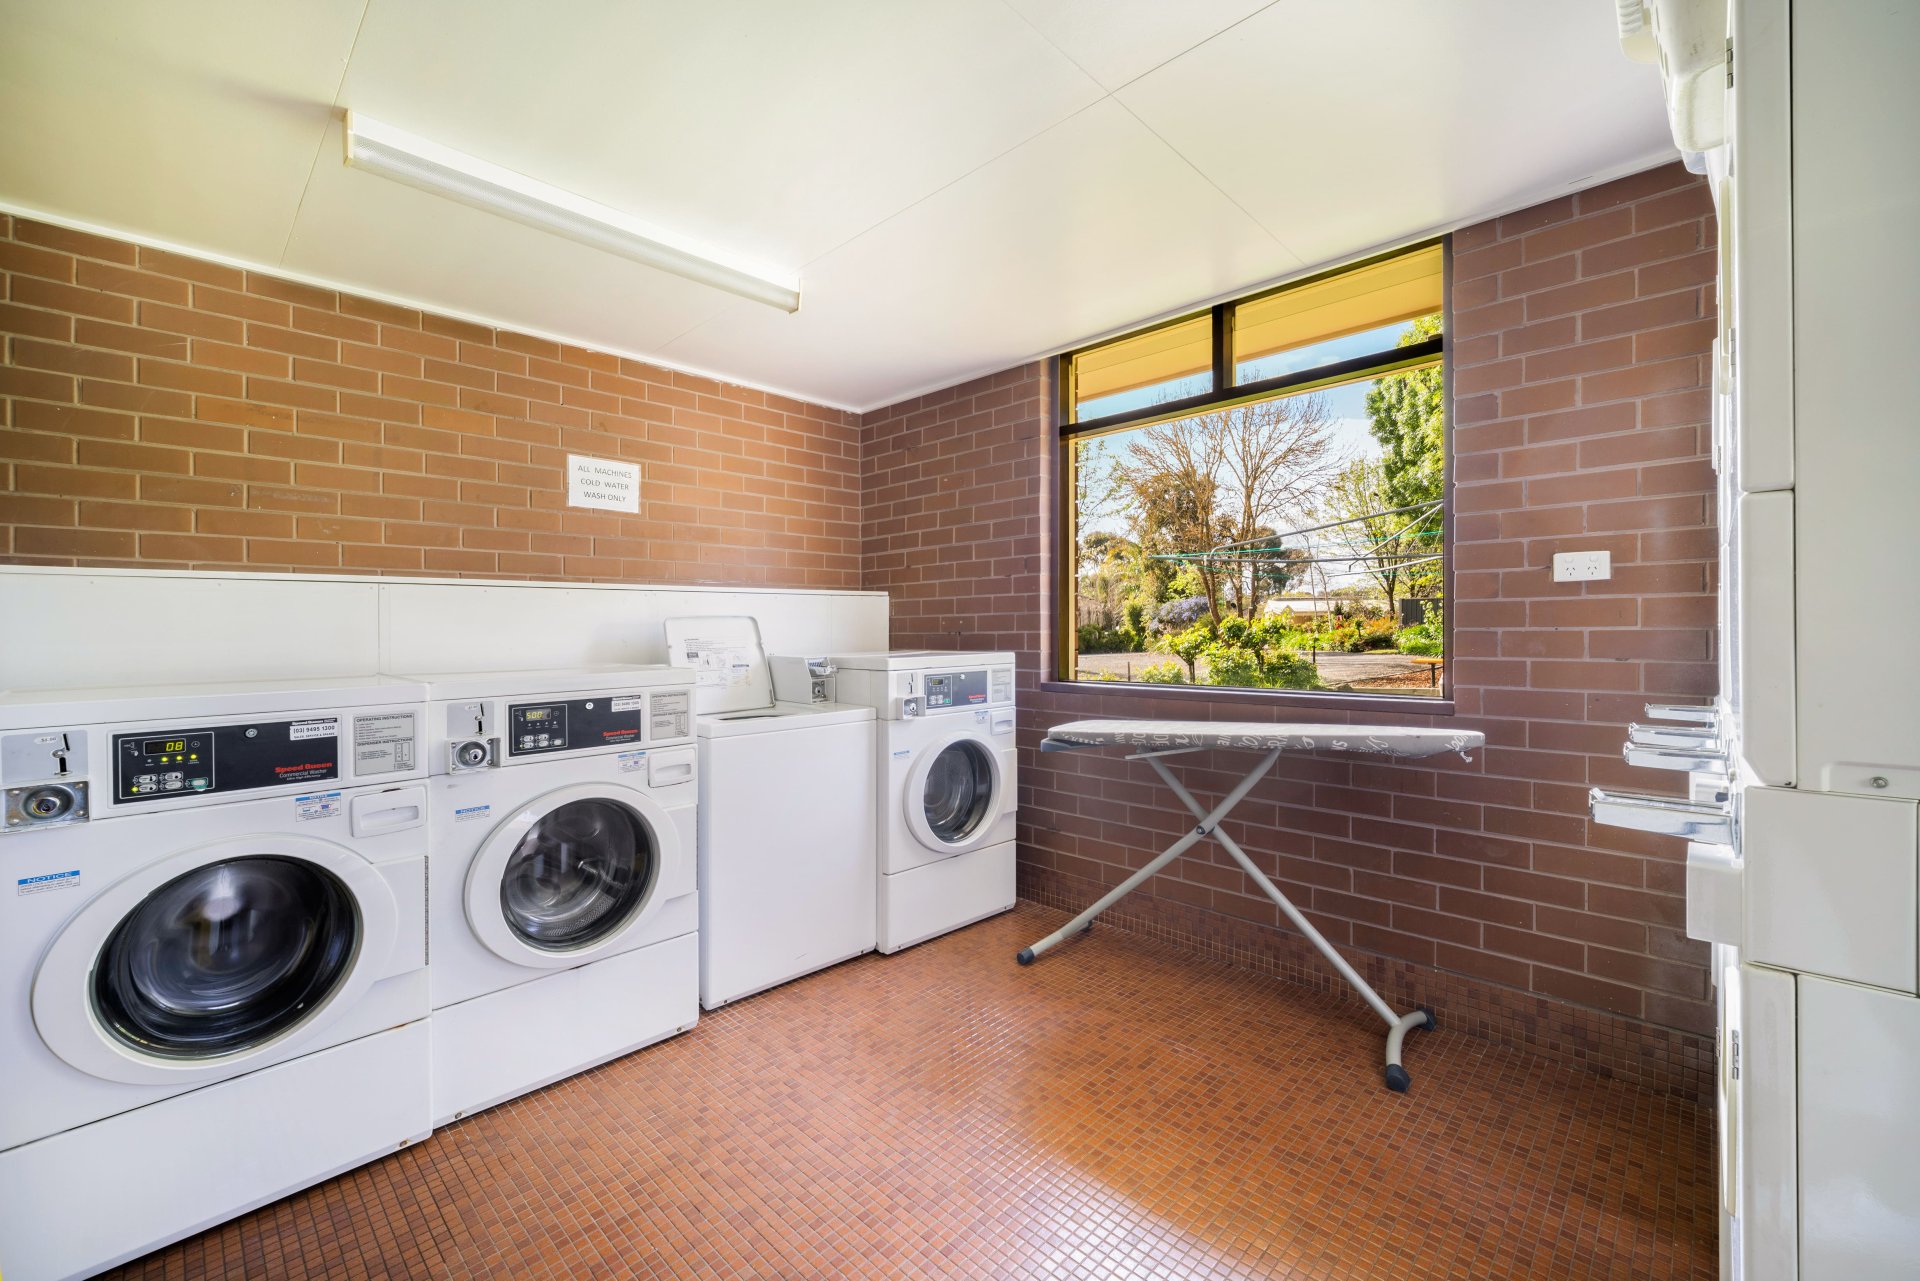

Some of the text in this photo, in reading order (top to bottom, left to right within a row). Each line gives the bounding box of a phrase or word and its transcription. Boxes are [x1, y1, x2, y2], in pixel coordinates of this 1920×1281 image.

[578, 465, 632, 479] ALL MACHINES
[580, 478, 629, 490] COLD WATER
[584, 491, 626, 502] WASH ONLY
[166, 741, 183, 752] 08
[274, 762, 333, 774] Speed Queen
[279, 770, 309, 779] Commercial
[27, 872, 71, 884] NOTICE
